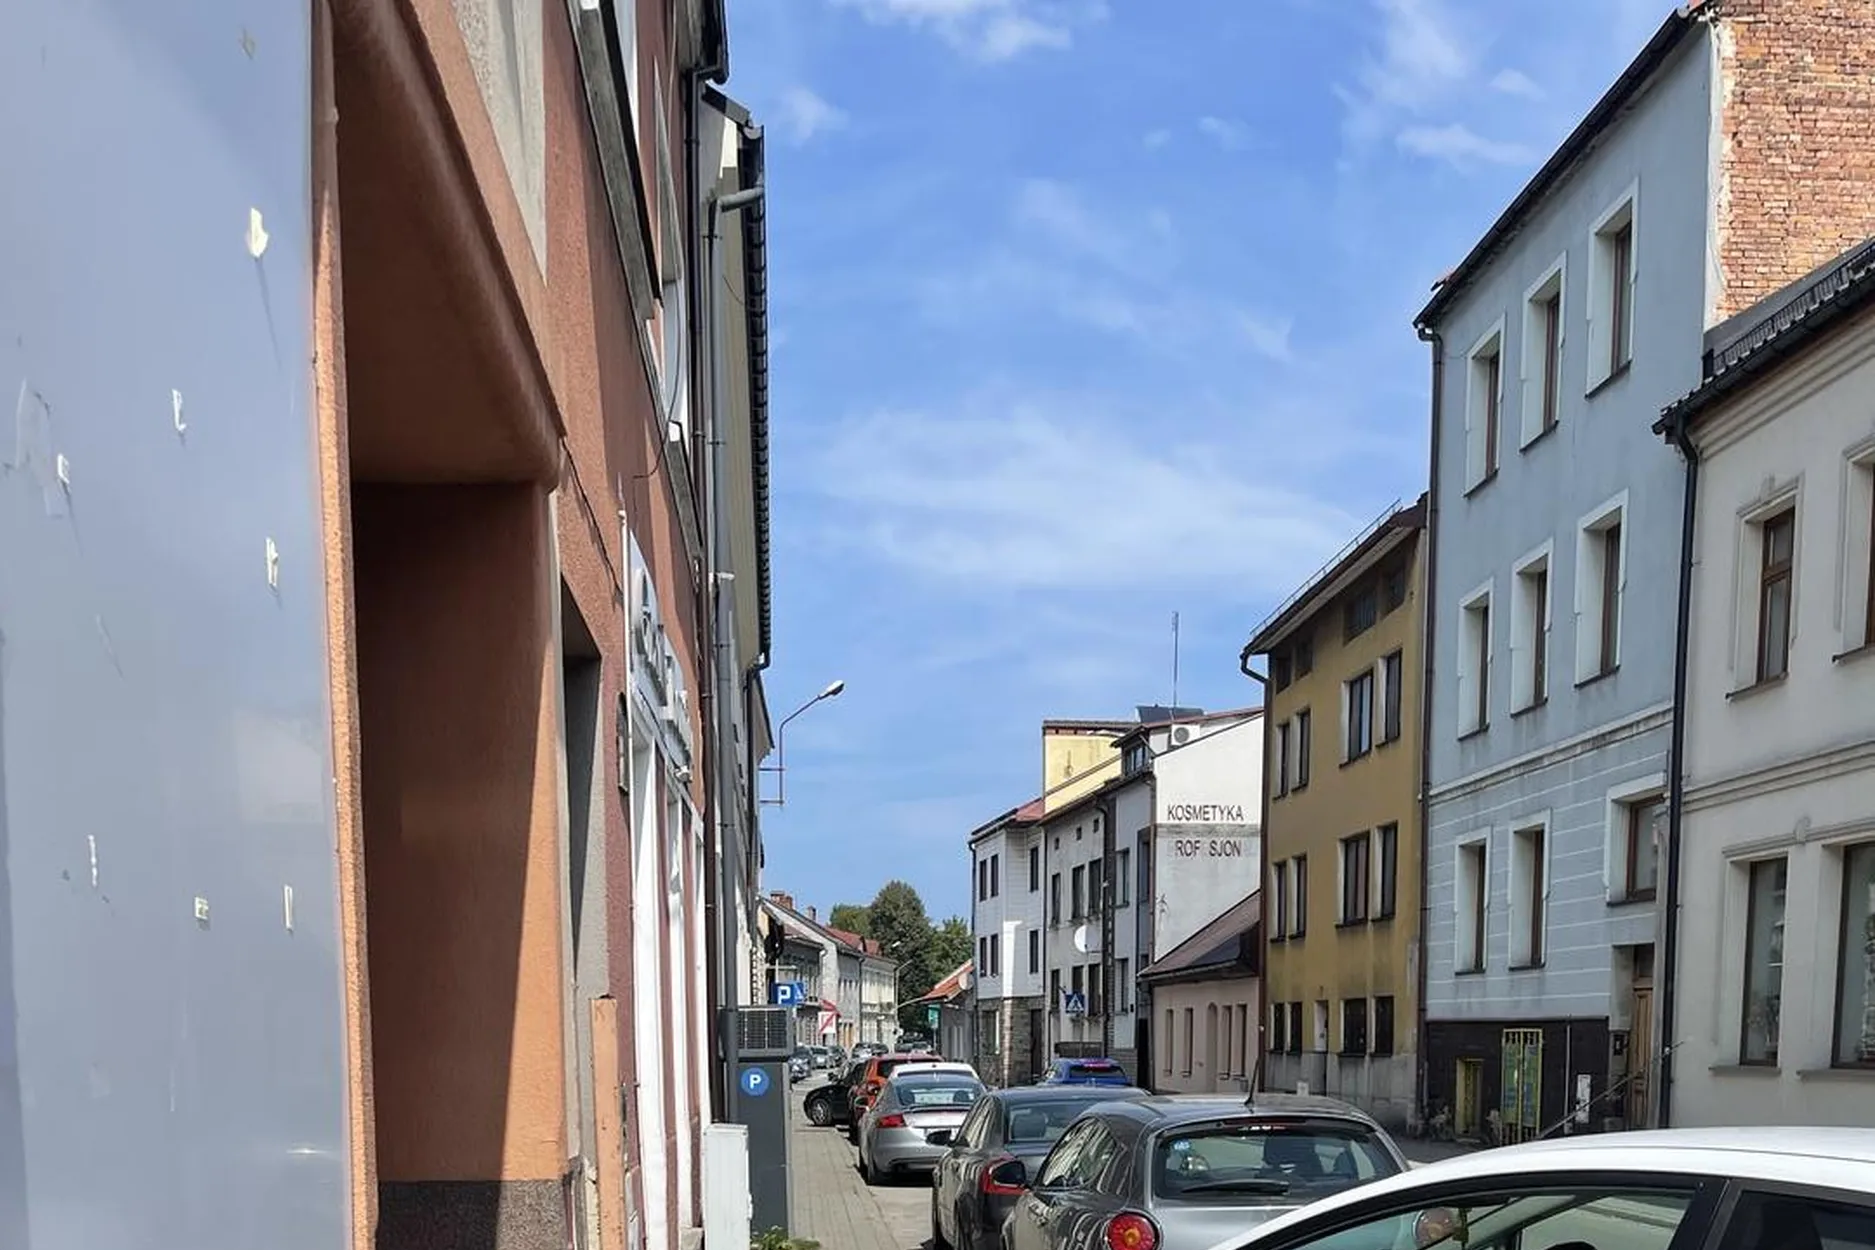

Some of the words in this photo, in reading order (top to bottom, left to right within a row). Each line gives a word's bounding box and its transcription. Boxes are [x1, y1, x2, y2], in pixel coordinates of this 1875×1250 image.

[1167, 804, 1244, 821] KOSMETYKA
[777, 986, 791, 1005] P
[749, 1074, 761, 1090] P
